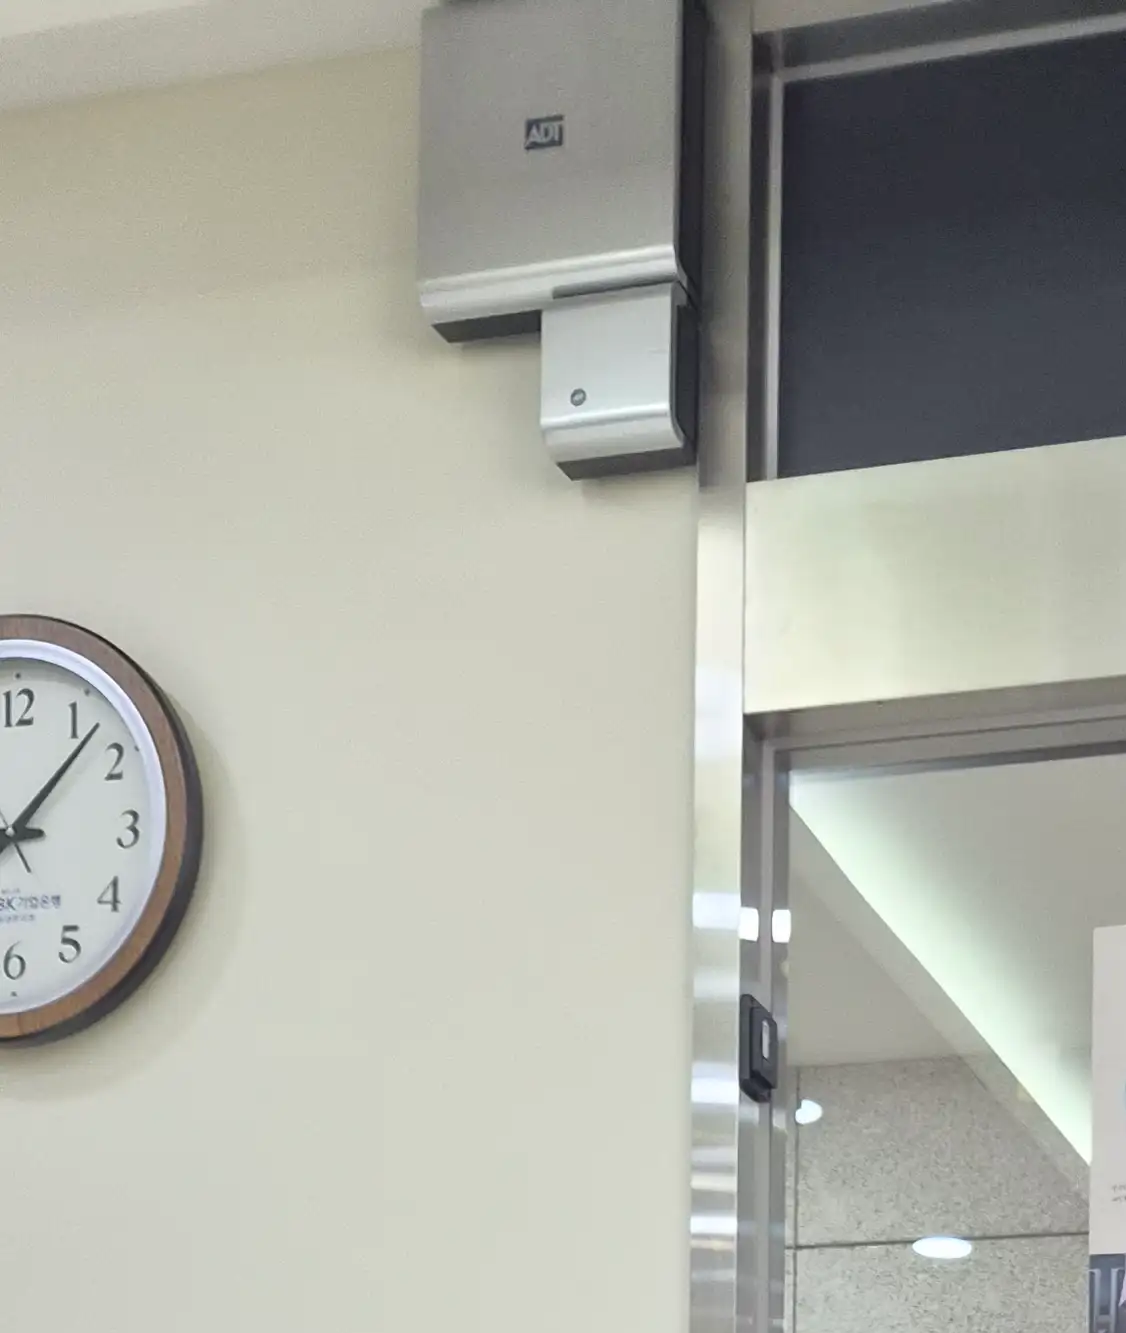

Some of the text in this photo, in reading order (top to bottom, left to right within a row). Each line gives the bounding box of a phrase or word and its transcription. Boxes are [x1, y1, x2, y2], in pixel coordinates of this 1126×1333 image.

[526, 123, 563, 145] ADT
[4, 688, 34, 728] 12
[68, 702, 79, 739] 1
[104, 742, 124, 780] 2
[116, 810, 140, 849] 3
[97, 876, 122, 912] 4
[4, 940, 26, 980] 6
[58, 925, 81, 963] 5
